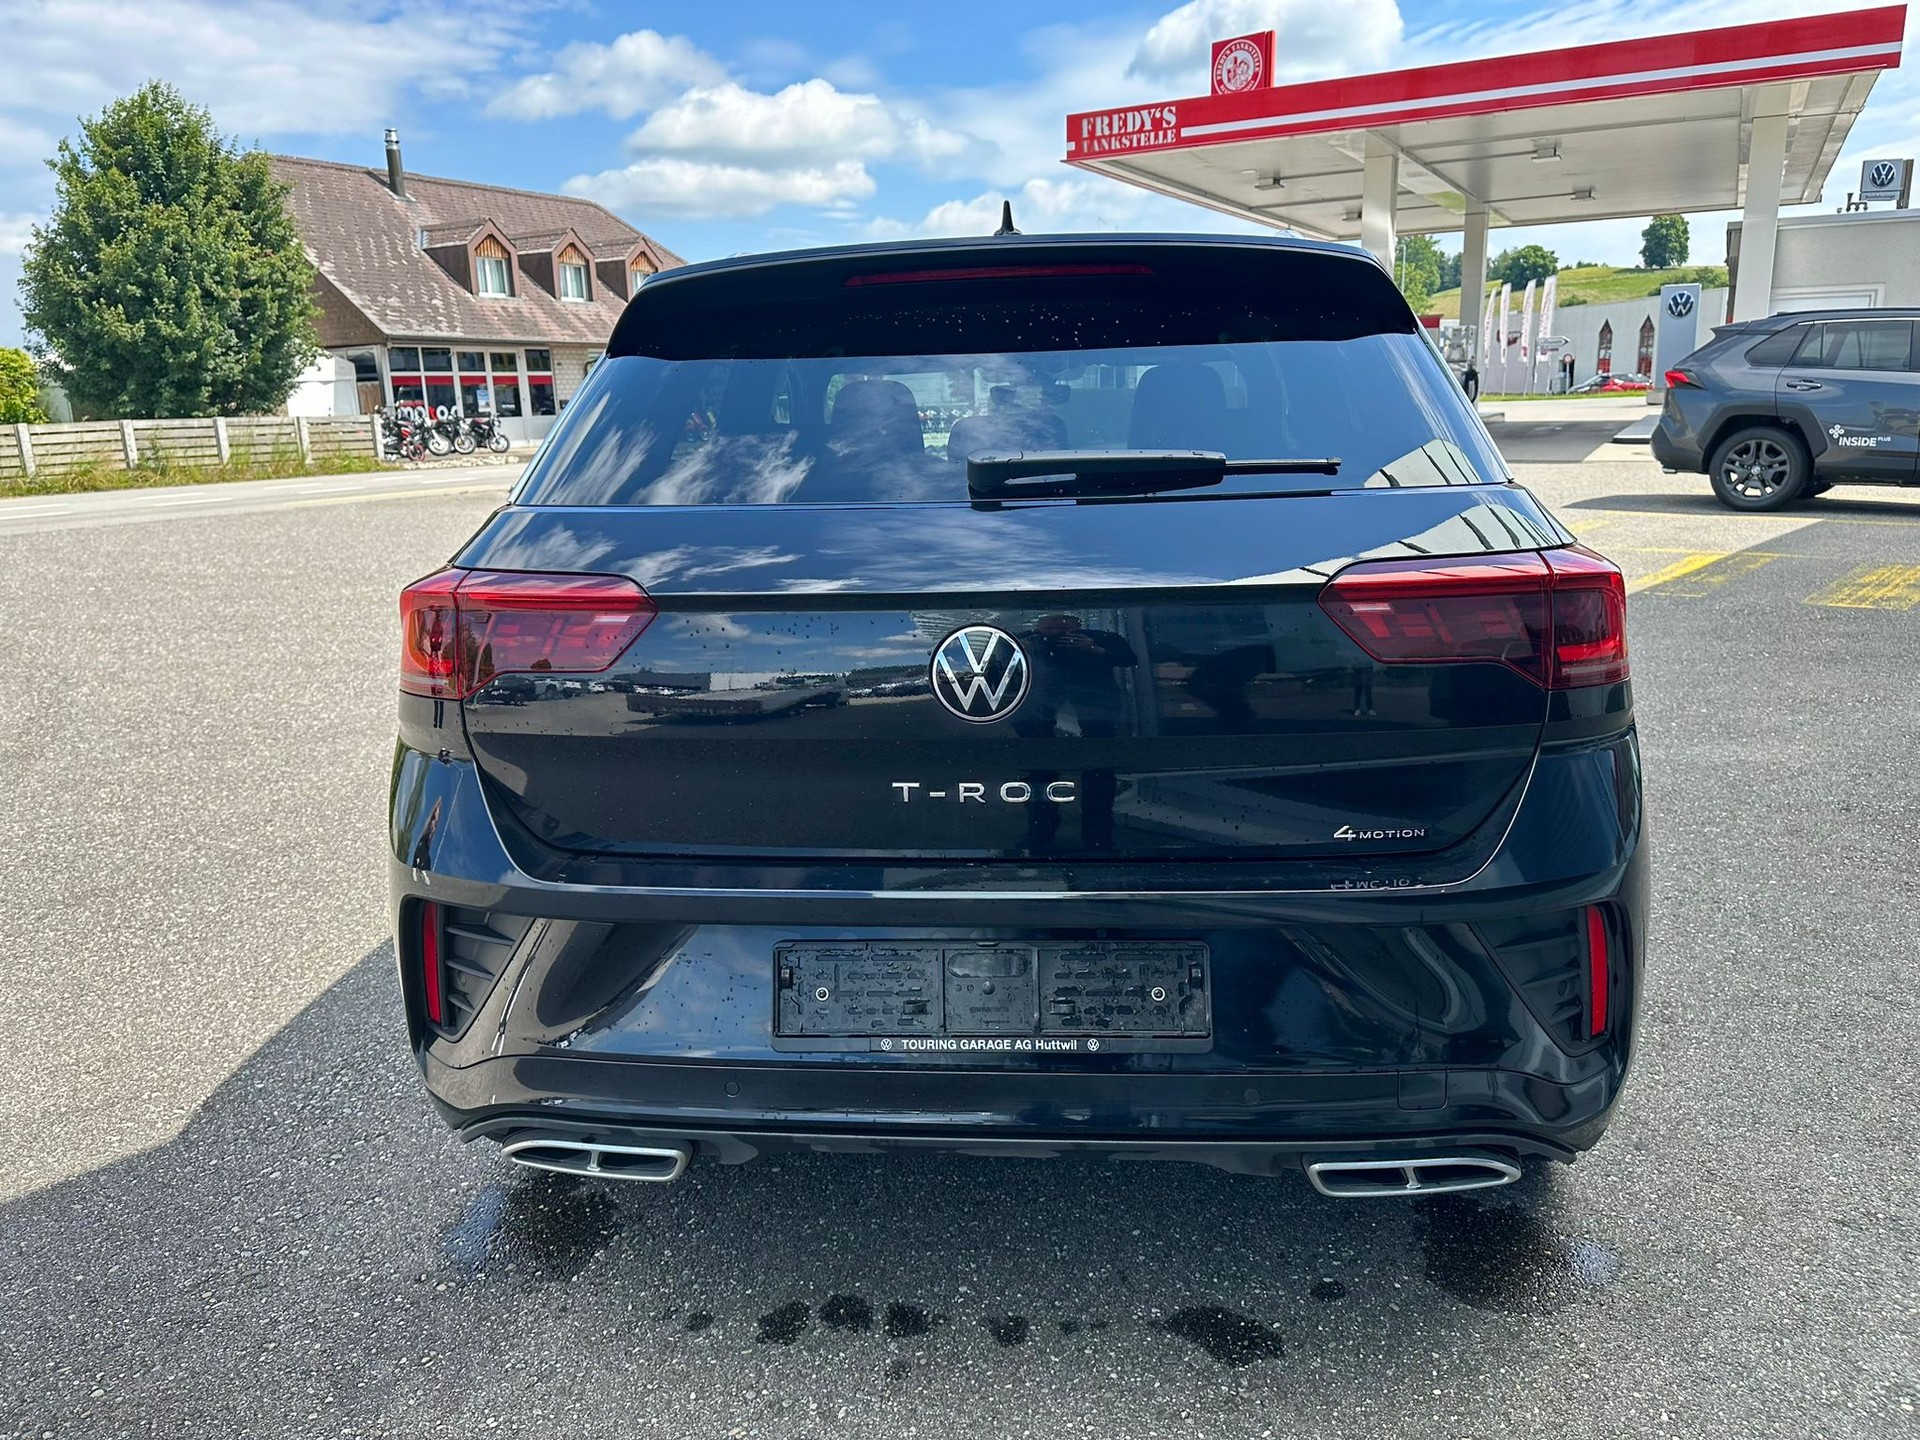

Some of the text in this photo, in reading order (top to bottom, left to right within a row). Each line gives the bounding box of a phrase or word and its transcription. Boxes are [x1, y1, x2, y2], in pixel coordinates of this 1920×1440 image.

[1082, 106, 1177, 138] FREDY'S
[1083, 129, 1176, 153] TANKSTELLE
[892, 782, 1075, 803] T-ROC
[901, 1039, 956, 1050] TOURING
[960, 1039, 1011, 1050] GARAGE
[1015, 1039, 1031, 1050] AG
[1035, 1039, 1077, 1050] Huttwil
